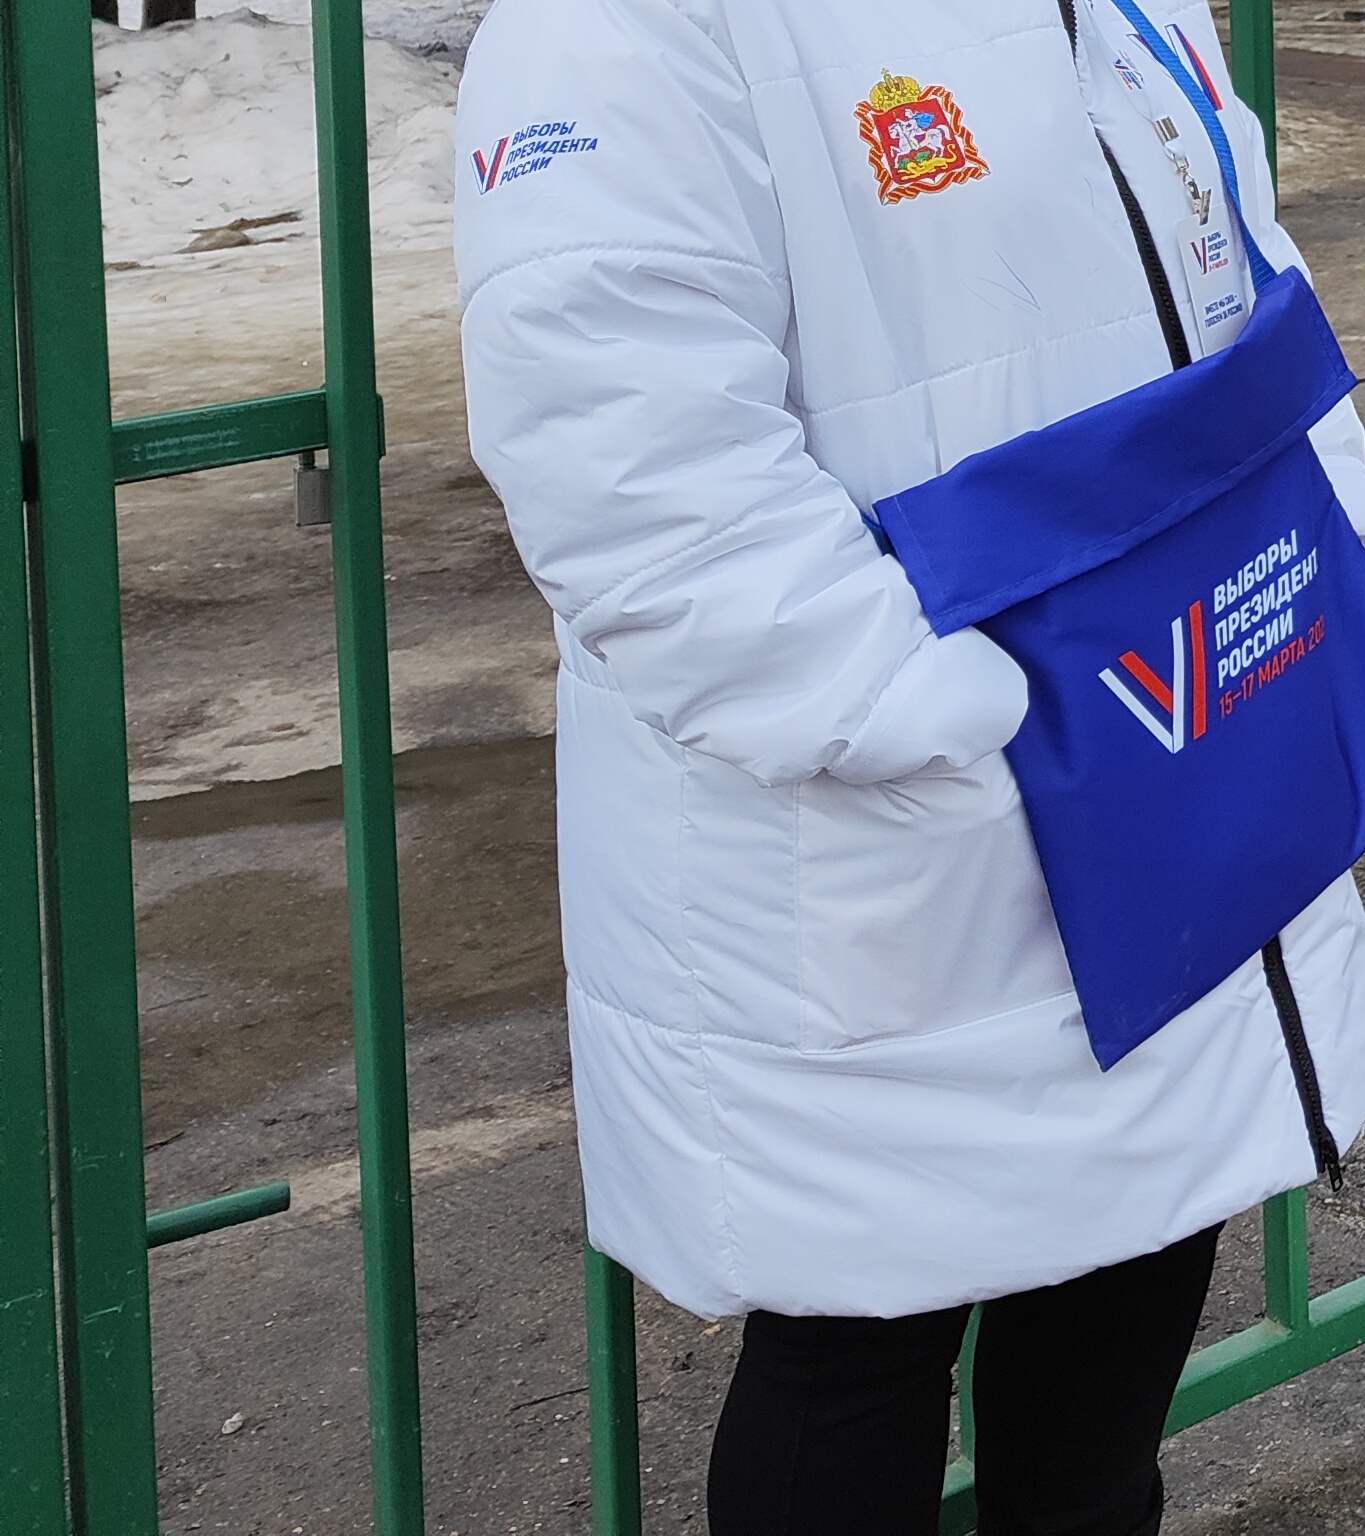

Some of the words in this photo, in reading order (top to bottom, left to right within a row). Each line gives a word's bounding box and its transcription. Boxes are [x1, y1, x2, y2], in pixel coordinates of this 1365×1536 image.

[505, 138, 599, 166] ПРЕЗИДЕНТА
[511, 121, 577, 147] ВЫБОРЫ
[499, 156, 553, 186] РОССИИ
[1213, 529, 1298, 614] ВЫБОРЫ
[1214, 546, 1318, 651] ПРЕЗИДЕНТ
[1217, 607, 1293, 689] РОССИИ
[1258, 637, 1306, 689] МАРТА
